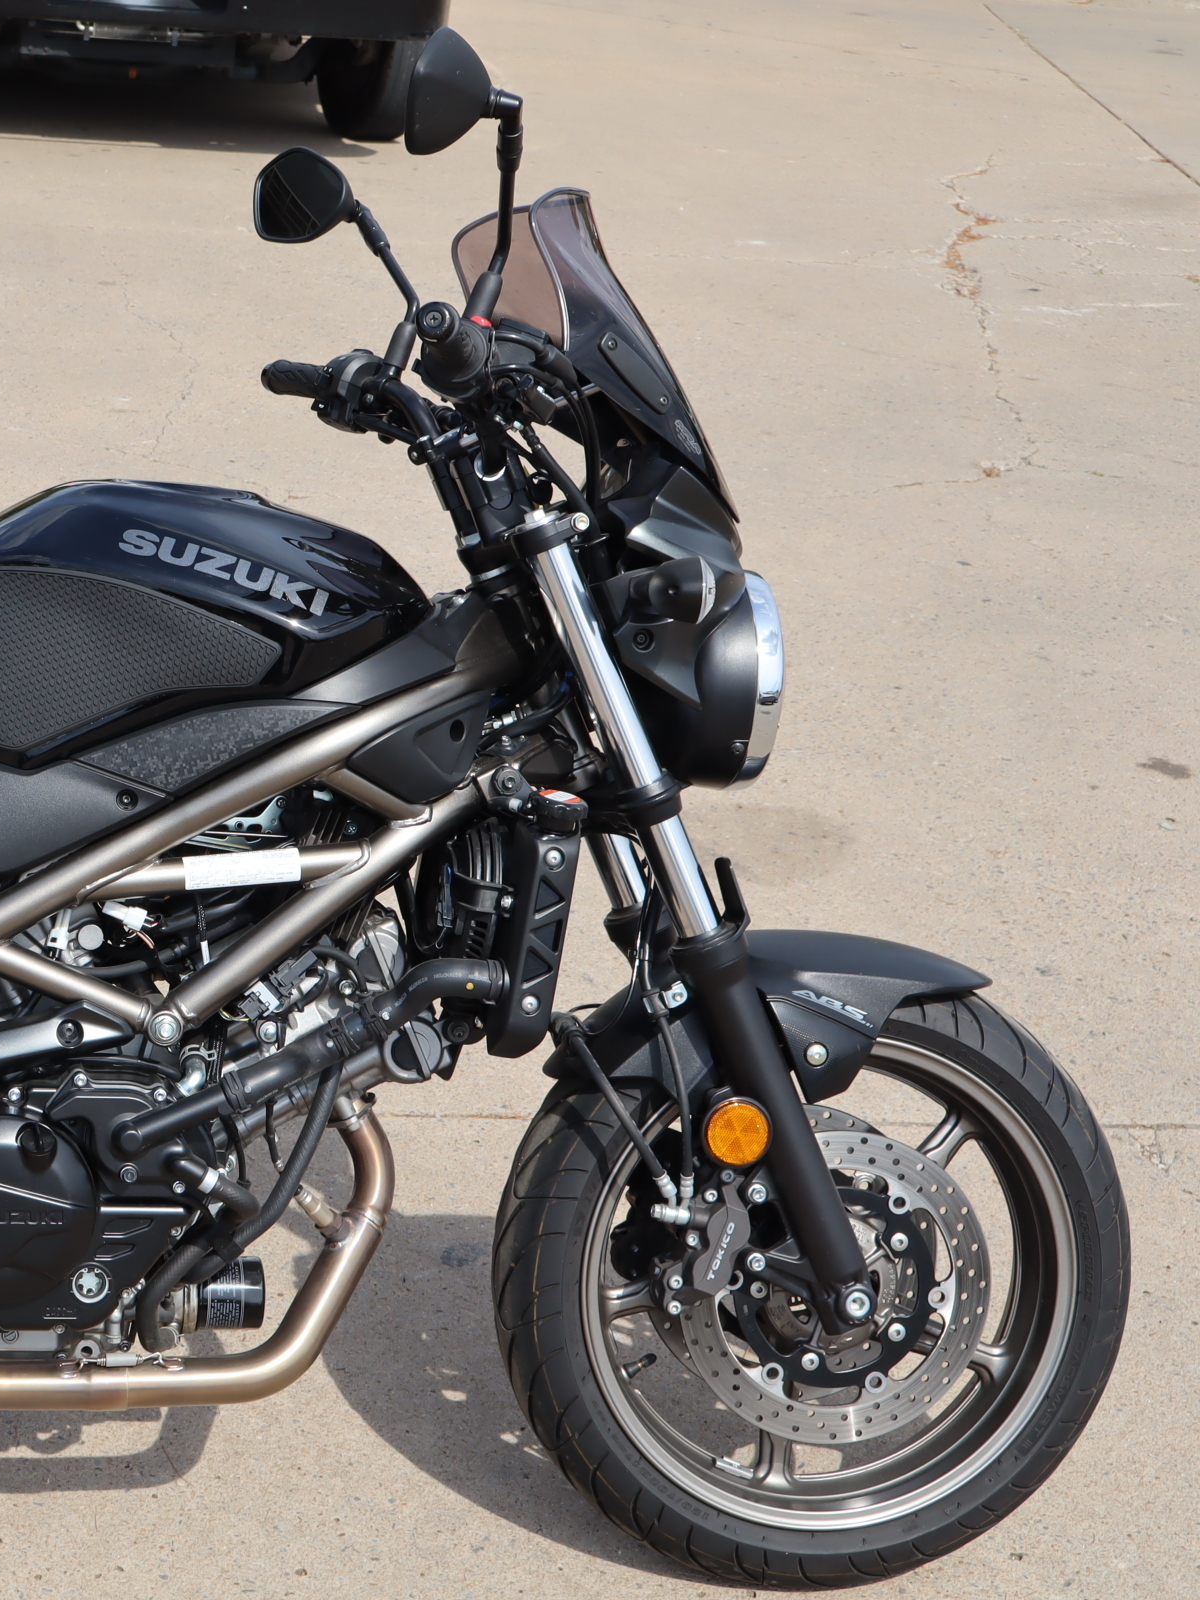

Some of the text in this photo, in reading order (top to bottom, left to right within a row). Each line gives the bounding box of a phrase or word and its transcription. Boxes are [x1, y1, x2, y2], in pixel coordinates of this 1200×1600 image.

[118, 528, 330, 617] SUZUKI
[791, 989, 870, 1023] ABS
[706, 1221, 735, 1281] TOKICO
